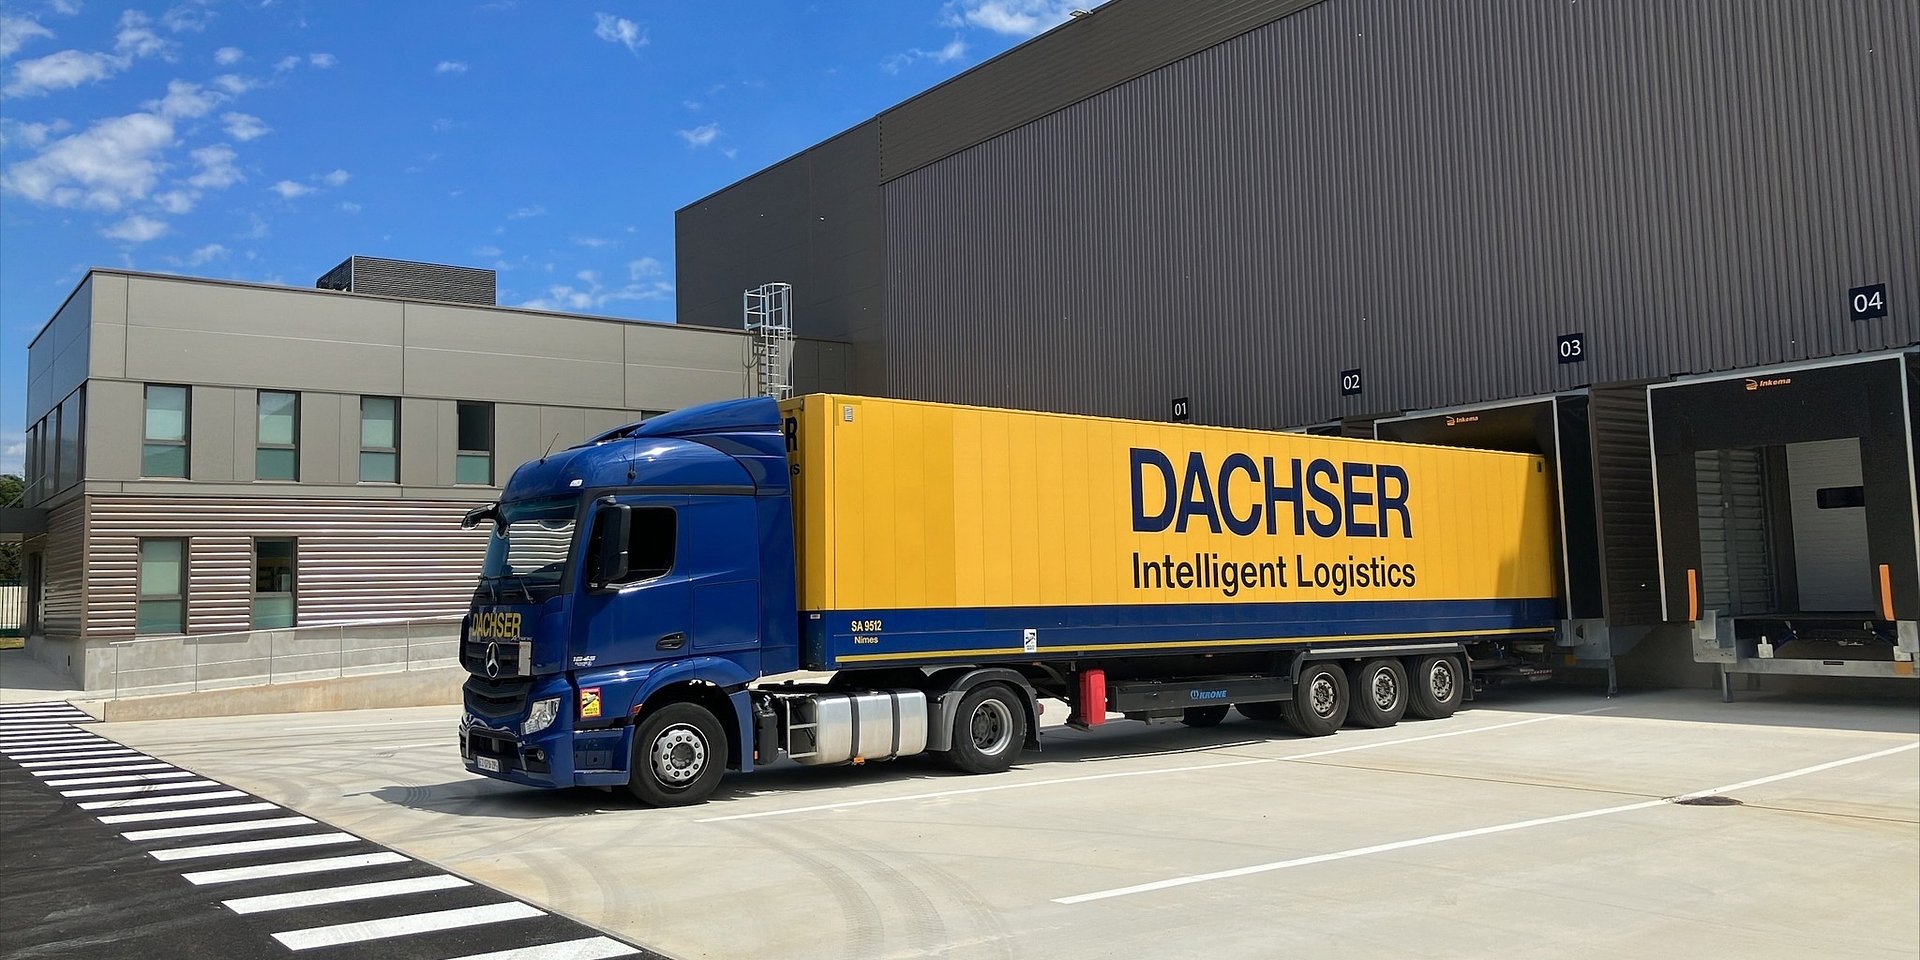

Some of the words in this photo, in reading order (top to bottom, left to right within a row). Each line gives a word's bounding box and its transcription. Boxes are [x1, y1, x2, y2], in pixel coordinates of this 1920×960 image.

[1853, 290, 1884, 313] 04
[1560, 339, 1582, 358] 03
[1343, 374, 1360, 390] 02
[1759, 378, 1791, 387] Inkema
[1174, 402, 1187, 416] 01
[1129, 447, 1413, 539] DACHSER
[1132, 552, 1288, 597] Intelligent
[1296, 554, 1416, 596] Logistics
[472, 612, 522, 638] DACHSER
[851, 620, 864, 632] SA
[864, 620, 882, 632] 9512
[1199, 690, 1227, 699] KRONE
